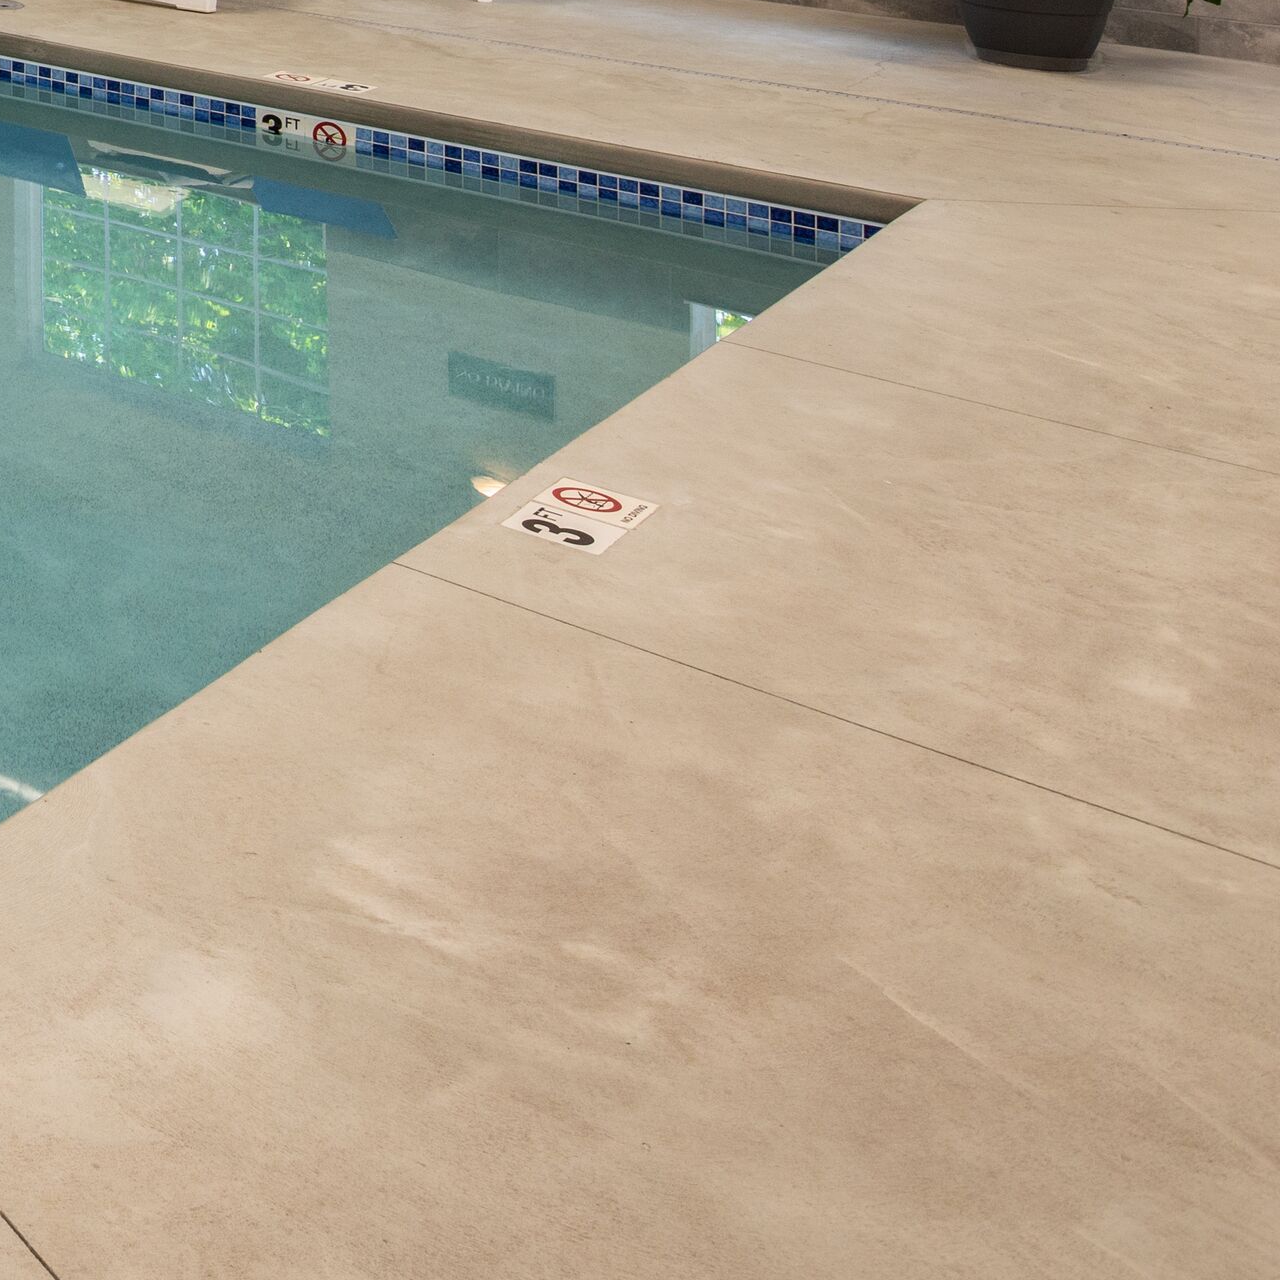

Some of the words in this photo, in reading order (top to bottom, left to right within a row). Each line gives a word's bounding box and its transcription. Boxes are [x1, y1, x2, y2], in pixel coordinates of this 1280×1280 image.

[262, 114, 283, 135] 3
[285, 117, 301, 130] FT
[533, 507, 563, 521] FT
[628, 504, 648, 518] DIVING
[521, 518, 595, 546] 3
